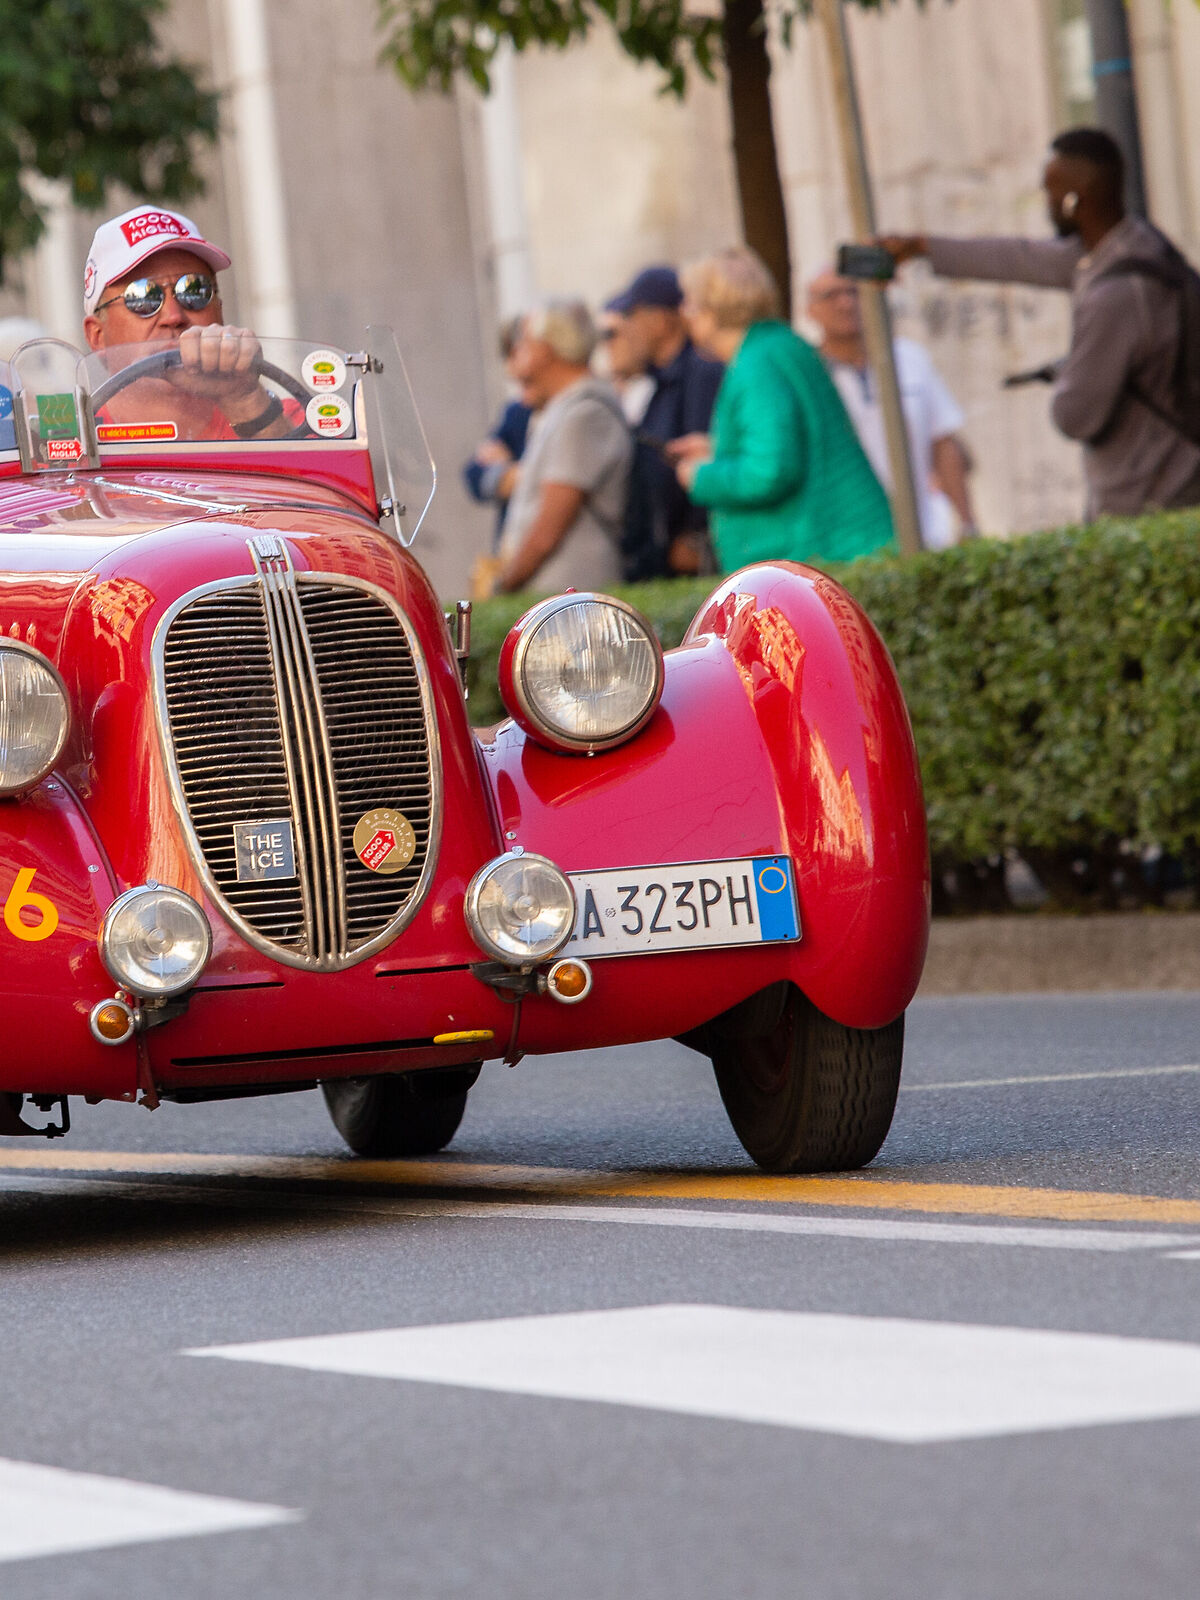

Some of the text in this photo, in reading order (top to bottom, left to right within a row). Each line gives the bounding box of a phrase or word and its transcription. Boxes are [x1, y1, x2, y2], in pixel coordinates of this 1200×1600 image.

[128, 214, 172, 230] 1000
[130, 224, 180, 242] MIGLIA
[50, 450, 78, 458] MIGLIA
[51, 442, 75, 450] 1000
[245, 833, 283, 851] THE
[363, 837, 383, 859] 1000
[250, 851, 285, 870] ICE
[369, 842, 392, 868] MIGLIA
[617, 874, 755, 936] 323PH
